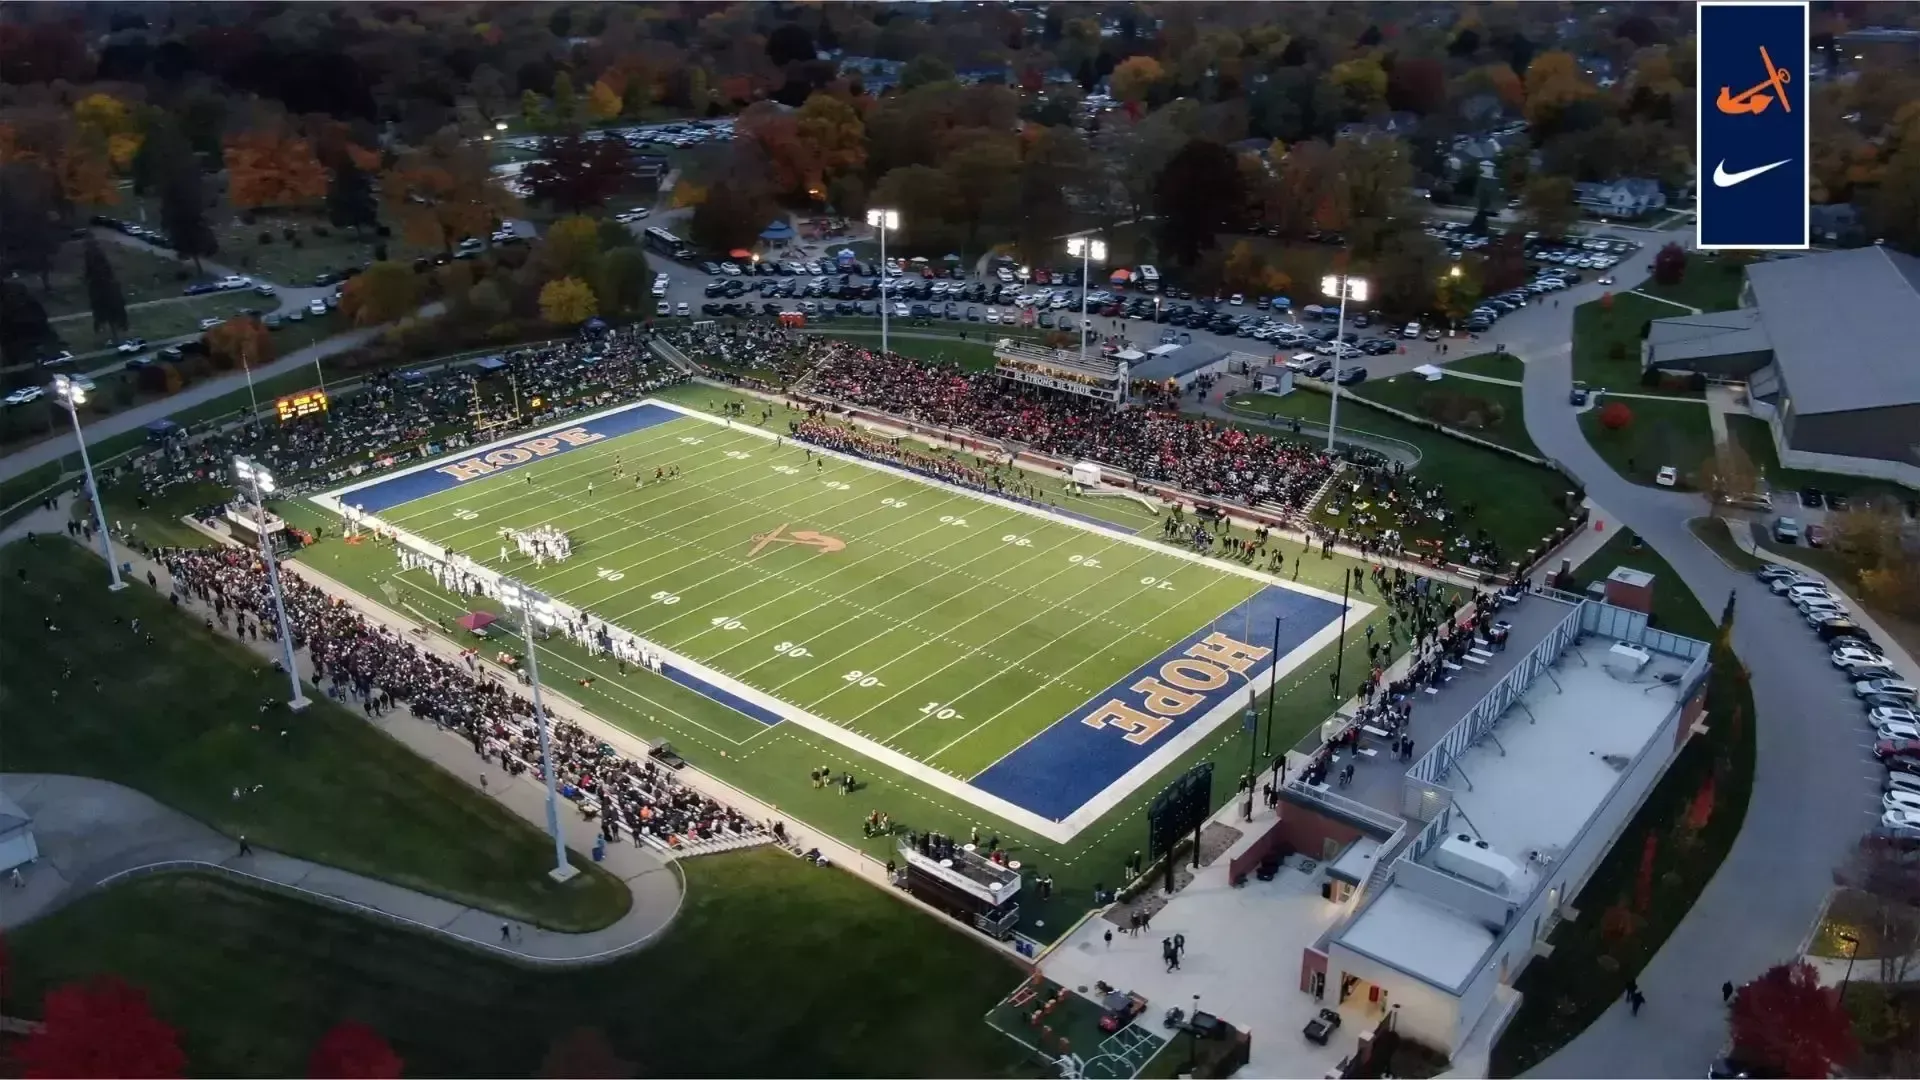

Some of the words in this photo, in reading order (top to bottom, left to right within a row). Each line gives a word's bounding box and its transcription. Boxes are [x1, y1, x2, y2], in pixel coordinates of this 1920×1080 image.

[435, 427, 606, 481] HOPE
[597, 569, 624, 581] 40
[1141, 577, 1172, 589] 10
[651, 590, 680, 604] 50
[711, 617, 741, 630] 40
[774, 641, 807, 657] 30
[841, 670, 878, 687] 20
[1081, 631, 1273, 745] HOPE
[918, 702, 956, 719] 10
